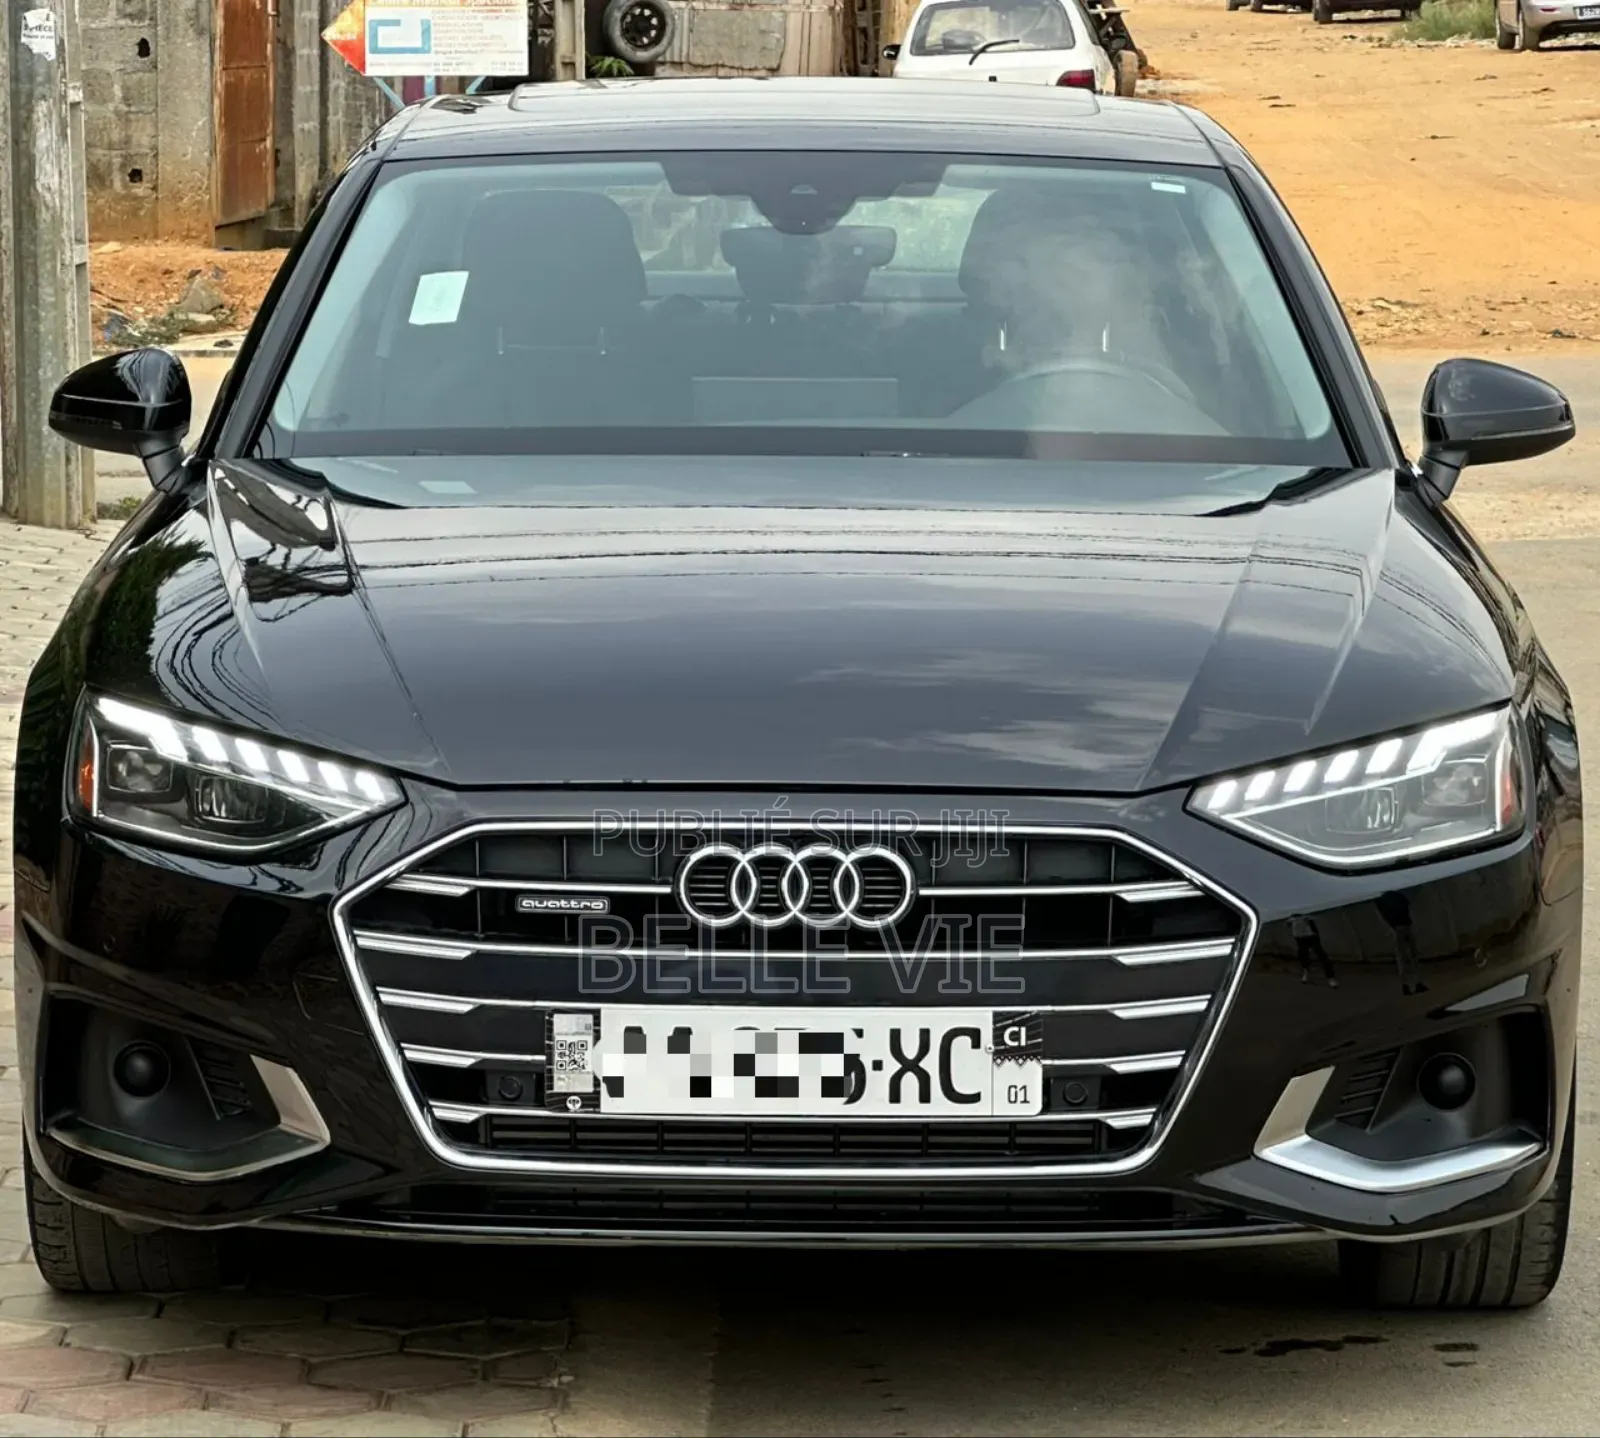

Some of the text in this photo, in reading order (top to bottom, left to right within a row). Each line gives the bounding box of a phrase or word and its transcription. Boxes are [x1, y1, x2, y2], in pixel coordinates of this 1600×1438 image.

[521, 898, 605, 910] quattro
[1003, 1026, 1026, 1046] CI
[1007, 1084, 1030, 1104] 01
